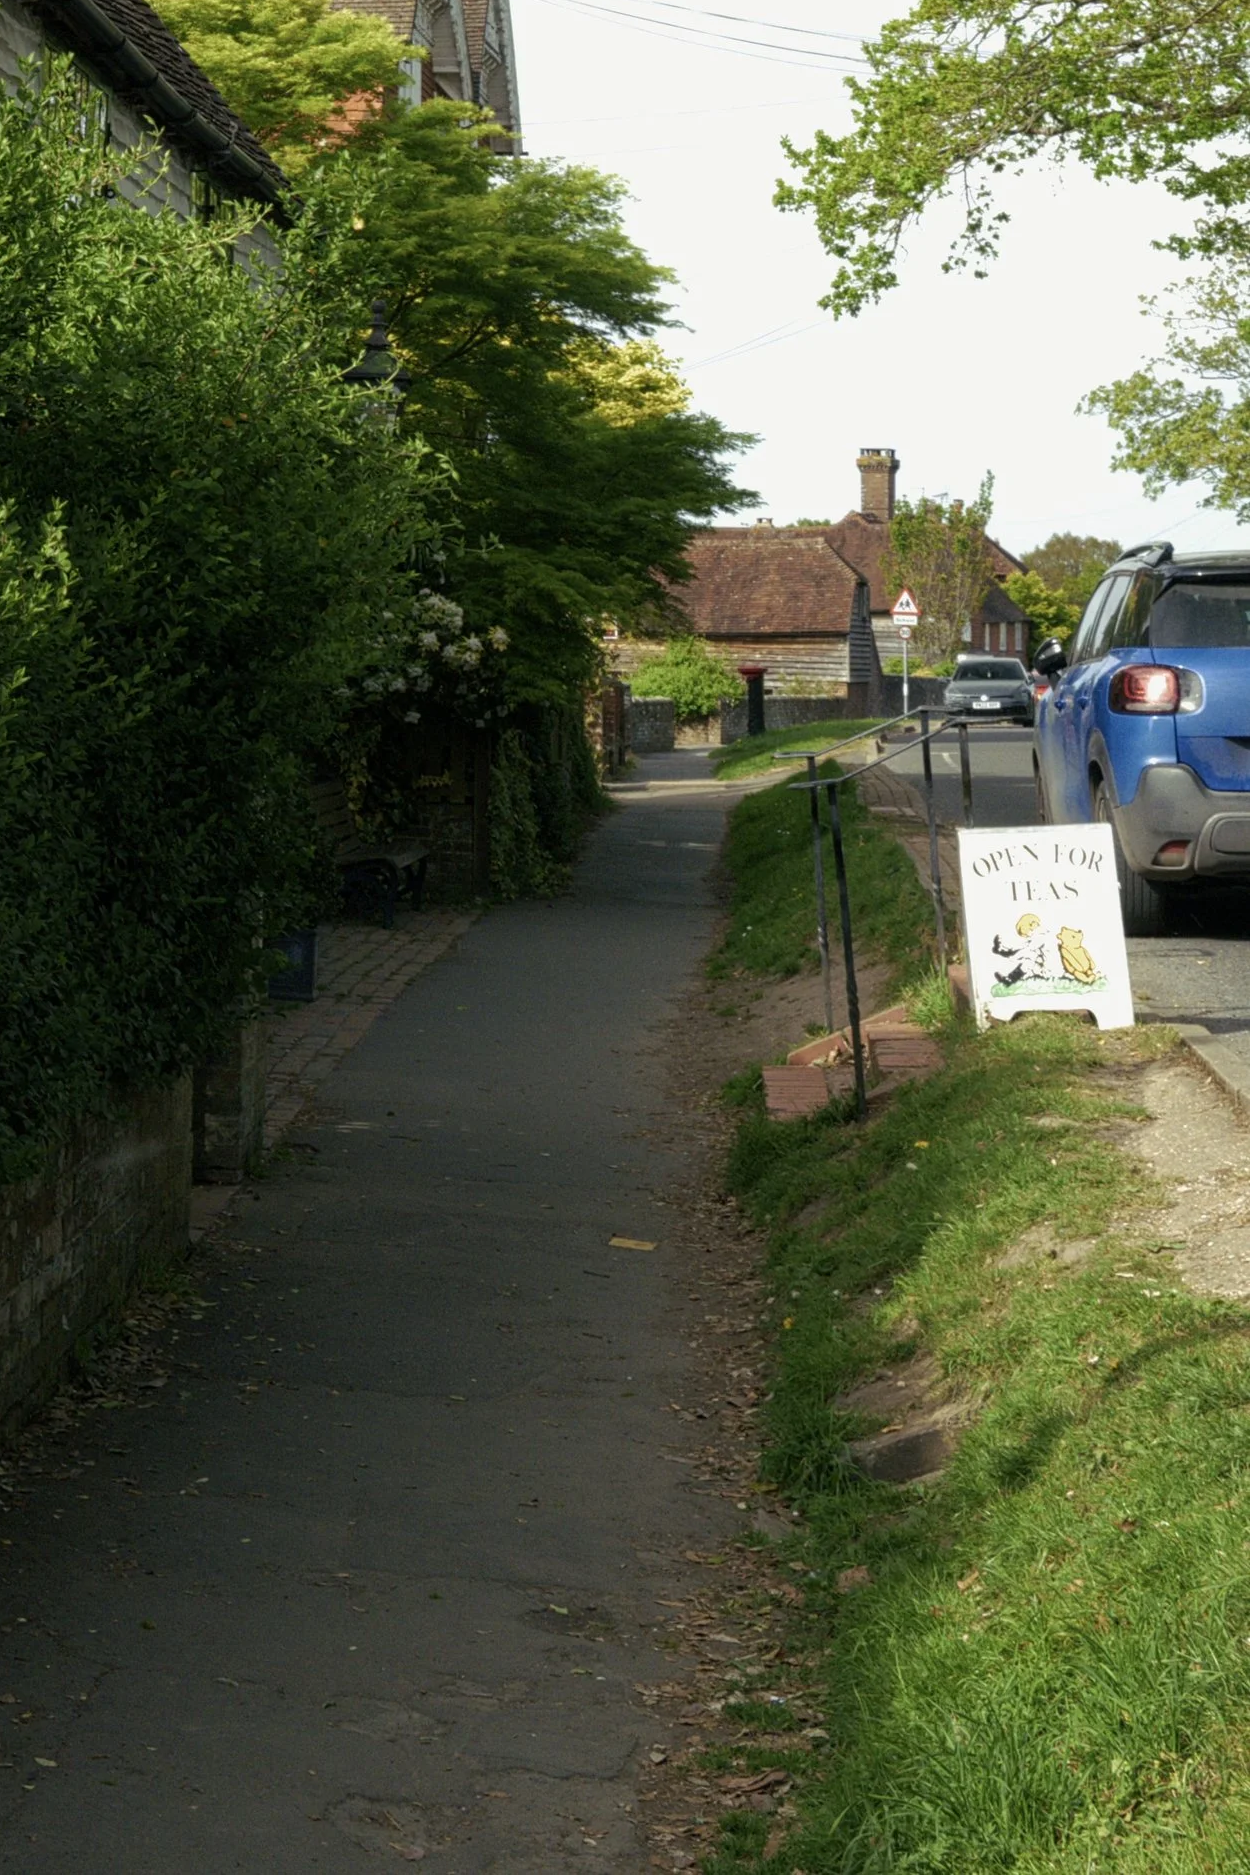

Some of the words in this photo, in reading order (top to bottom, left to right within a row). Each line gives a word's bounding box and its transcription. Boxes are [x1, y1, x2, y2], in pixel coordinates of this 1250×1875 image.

[972, 843, 1039, 877] OPEN
[1054, 843, 1103, 873] FOR
[1005, 880, 1079, 902] TEAS
